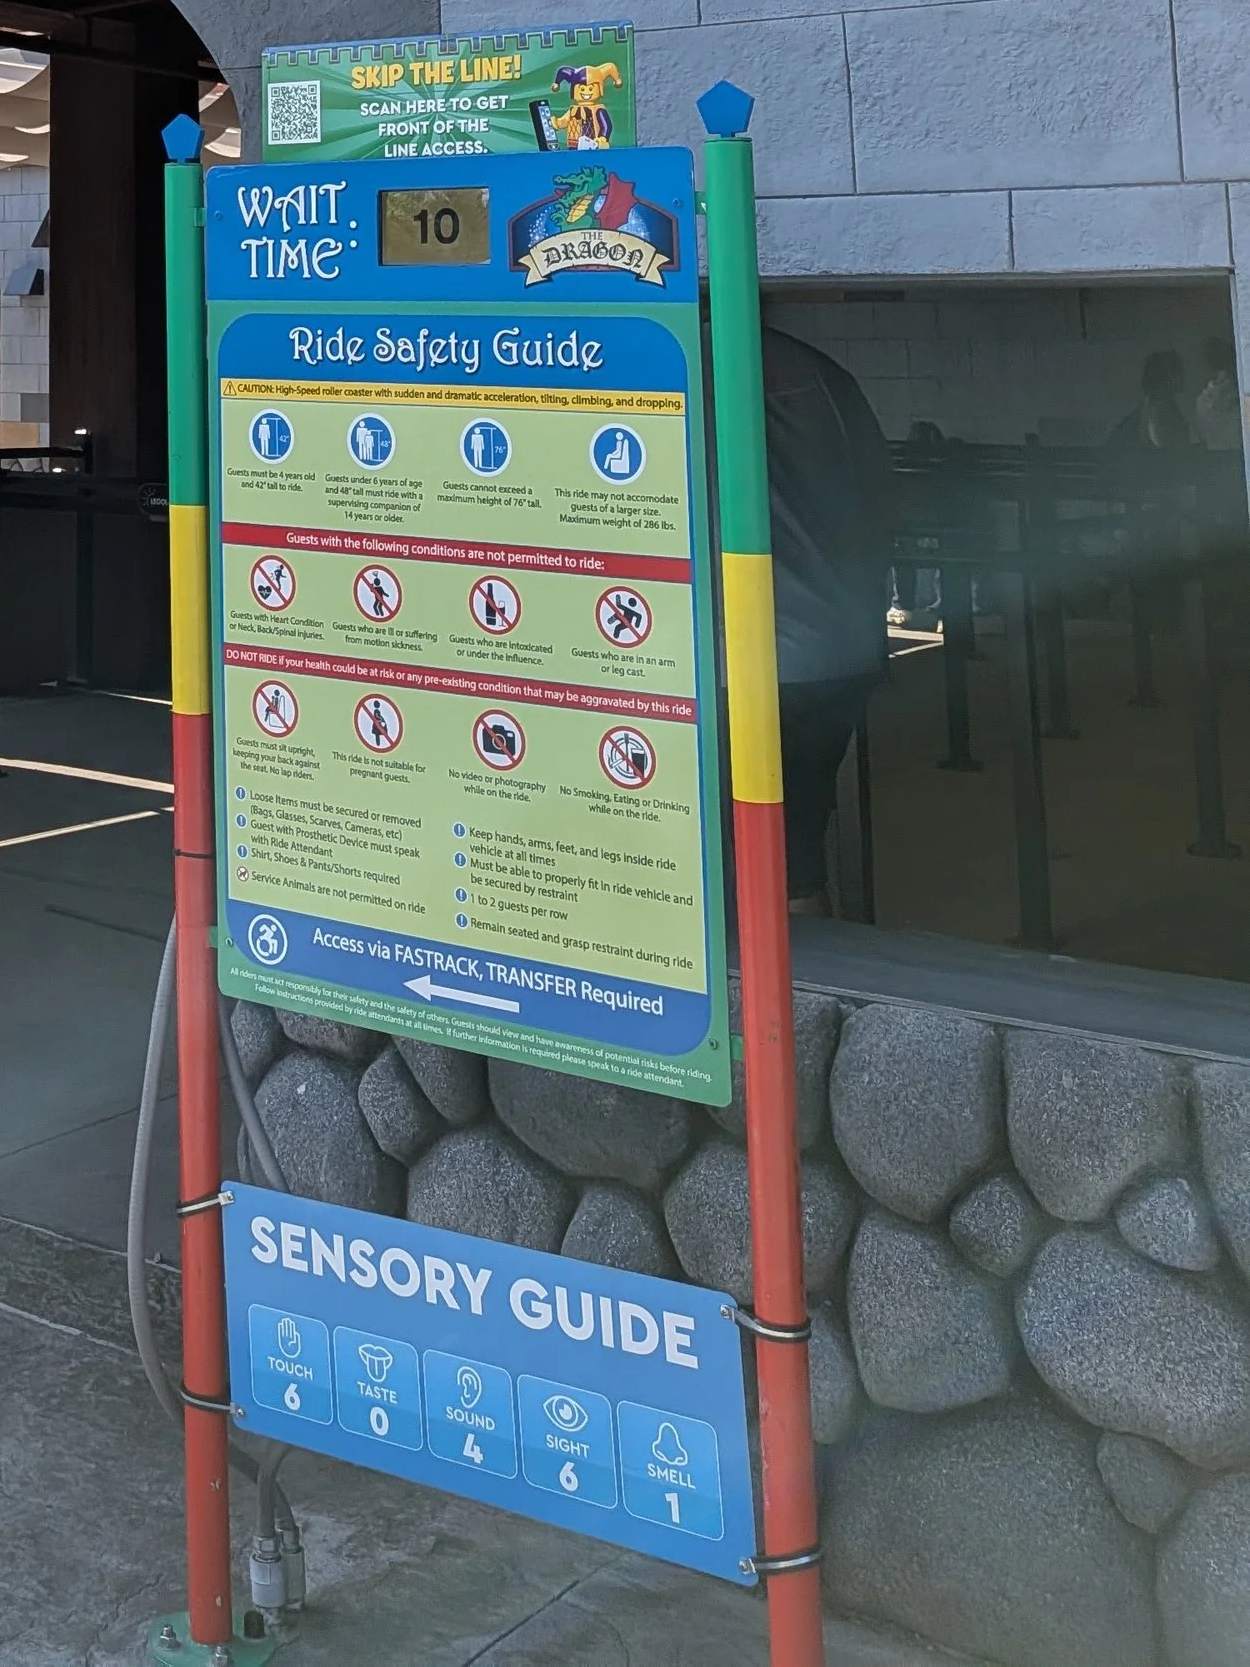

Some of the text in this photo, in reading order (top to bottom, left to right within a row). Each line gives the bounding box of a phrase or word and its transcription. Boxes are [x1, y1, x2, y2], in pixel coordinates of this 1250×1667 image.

[351, 55, 522, 90] SKIP THE LINE!
[360, 95, 509, 116] SCAN HERE TO GET
[378, 118, 489, 137] FRONT OF THE
[384, 140, 488, 158] LINE ACCESS.
[237, 181, 346, 232] WAIT
[413, 208, 459, 245] 10
[581, 232, 603, 241] THE
[541, 241, 644, 269] DRAGON
[289, 326, 603, 373] Ride Safety Guide
[237, 383, 682, 410] CAUTION: High-Speed roller coaster with sudden and dramatic acceleration, tilting, climbing, and dropping.
[226, 467, 249, 476] Guests
[268, 469, 278, 478] be
[284, 472, 303, 480] years
[303, 472, 315, 480] old
[240, 480, 254, 488] and
[254, 480, 266, 489] 42"
[266, 481, 278, 489] tall
[287, 482, 302, 491] ride.
[555, 487, 571, 497] This
[572, 489, 589, 498] ride
[590, 492, 608, 501] may
[610, 492, 625, 501] not
[559, 513, 676, 530] Maximum weight of 286 lbs.
[570, 503, 598, 512] guests
[599, 503, 608, 512] of
[616, 504, 641, 516] larger
[642, 506, 661, 516] size.
[286, 532, 604, 570] Guests with the following conditions are not permitted to ride:
[226, 649, 691, 715] DO NOT RIDE if your health could be at risk or any pre-existing condition that may be aggravated by this ride
[249, 789, 274, 803] Loose
[299, 800, 321, 811] must
[322, 801, 333, 813] be
[335, 806, 368, 819] secured
[370, 812, 380, 820] or
[382, 814, 421, 828] removed
[250, 804, 274, 819] (Bags,
[275, 809, 308, 824] Glasses,
[309, 814, 343, 830] Scarves,
[344, 820, 383, 838] Cameras,
[250, 834, 332, 857] with Ride Attendant
[469, 826, 676, 870] Keep hands, arms, feet, and legs inside ride
[469, 843, 555, 866] vehicle at all times
[470, 893, 568, 920] 1 to 2 guests per row
[470, 917, 692, 969] Remain seated and grasp restraint during ride
[312, 927, 662, 1015] Access via FASTRACK, TRANSFER Required
[251, 1216, 699, 1369] SENSORY GUIDE
[268, 1356, 313, 1381] TOUCH
[284, 1382, 301, 1411] 6
[357, 1382, 398, 1405] TASTE
[369, 1406, 390, 1436] 0
[446, 1405, 495, 1431] SOUND
[463, 1434, 483, 1464] 4
[546, 1434, 590, 1459] SIGHT
[558, 1462, 578, 1492] 6
[647, 1462, 696, 1489] SMELL
[664, 1492, 681, 1524] 1
